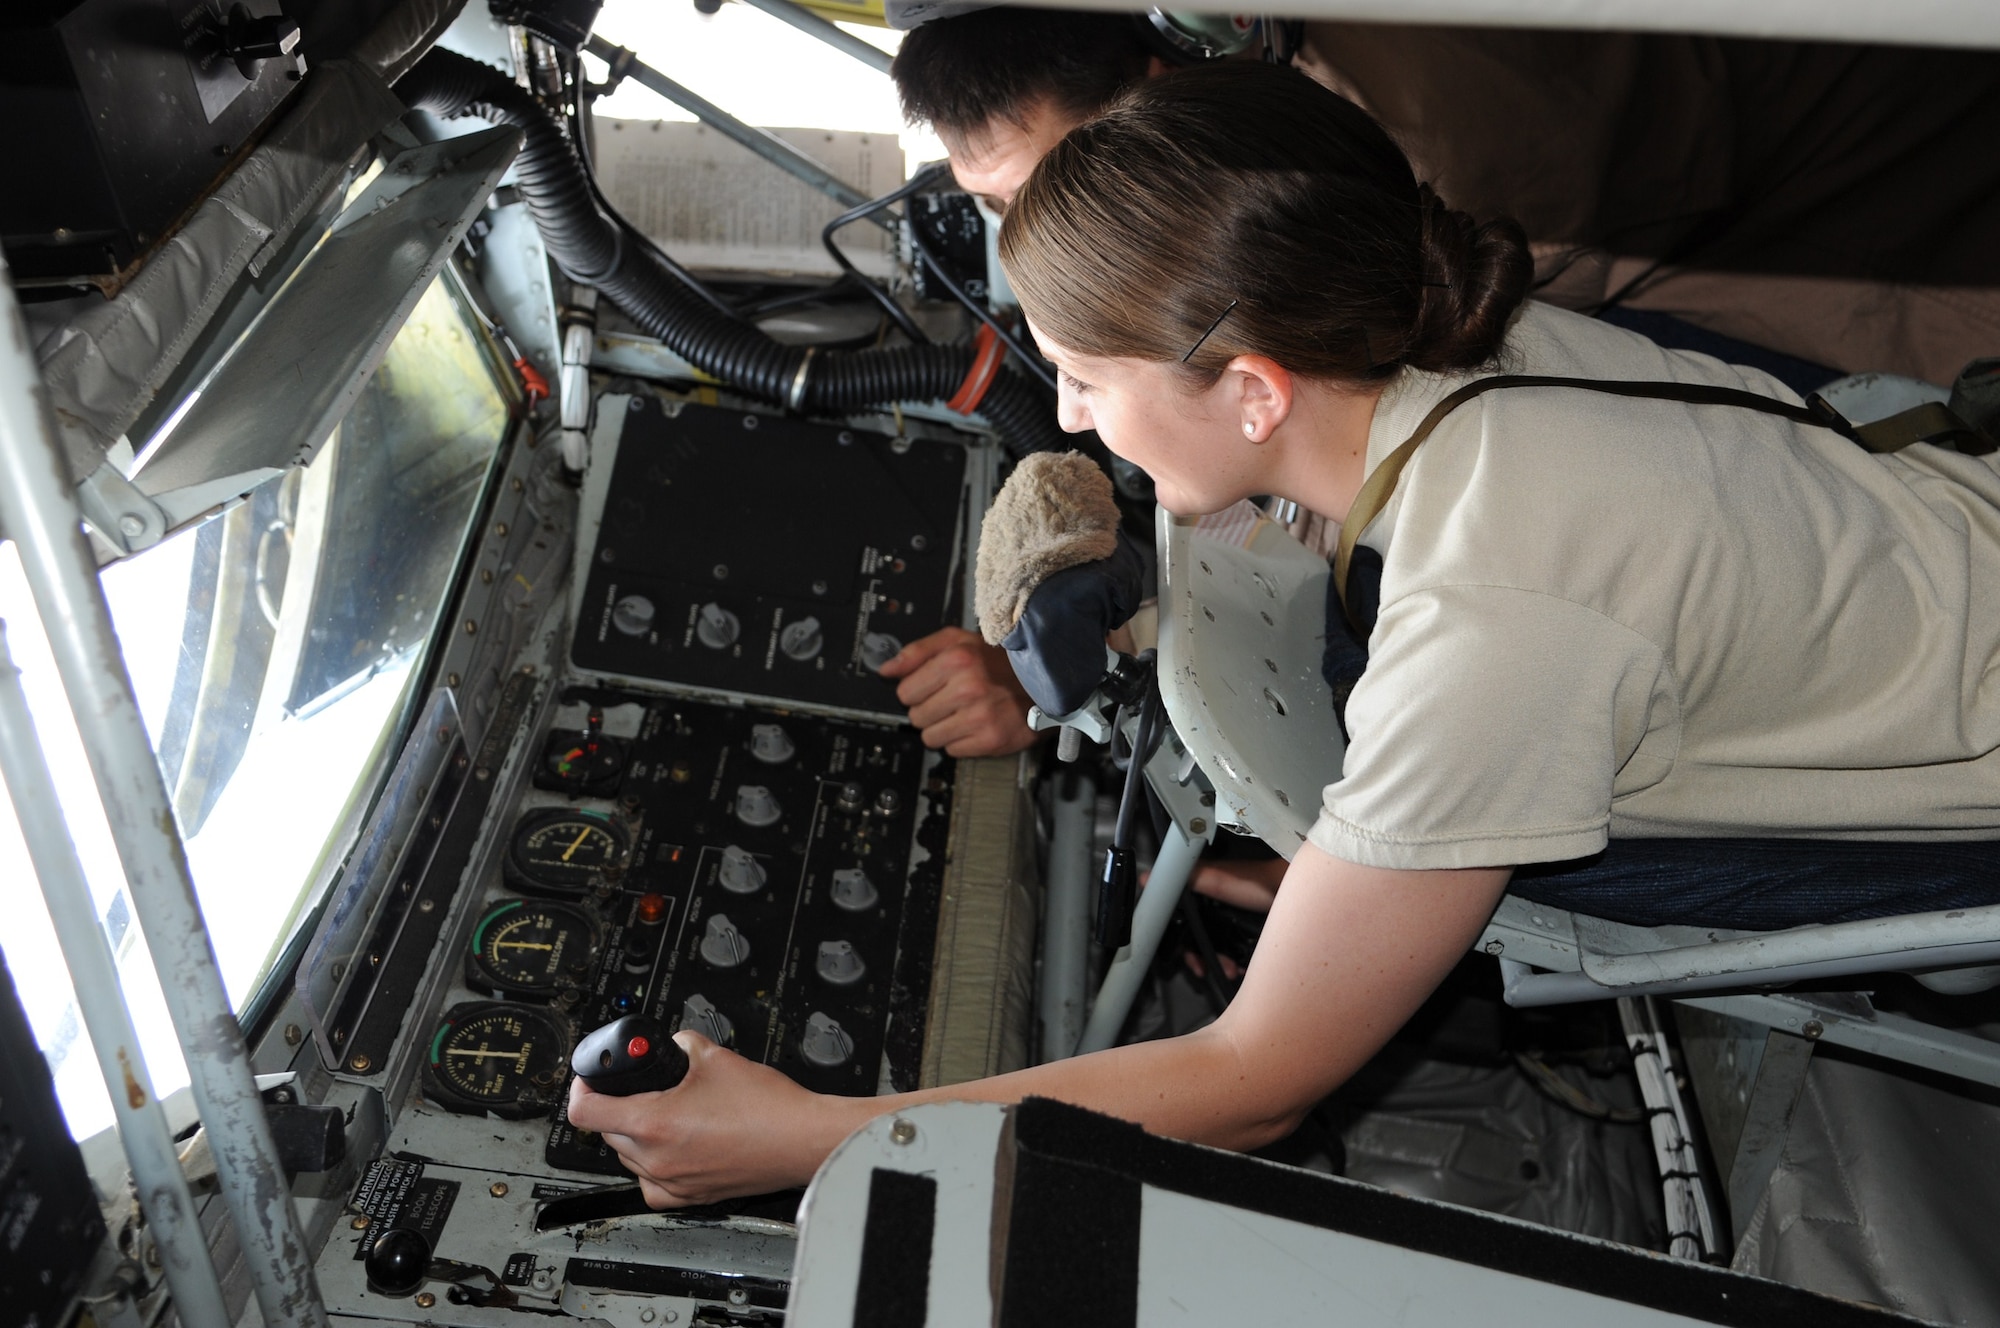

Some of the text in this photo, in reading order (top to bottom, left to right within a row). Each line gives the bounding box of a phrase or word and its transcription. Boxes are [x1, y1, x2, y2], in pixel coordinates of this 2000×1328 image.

[545, 930, 568, 973] TELESCOPING
[596, 925, 624, 995] SIGNAL SYSTEM STATUS
[658, 972, 673, 1001] DIRECTOR
[667, 950, 680, 971] LIGHTS
[511, 1021, 523, 1037] LEFT
[474, 1042, 489, 1064] DEGEES
[514, 1041, 533, 1074] AZIMUTH
[491, 1073, 506, 1093] RIGHT
[549, 1124, 564, 1148] AERIAL
[562, 1130, 572, 1144] TEST
[355, 1160, 382, 1206] WARNING
[366, 1165, 393, 1215] DO NOT TELESCO
[384, 1203, 400, 1229] MASTER
[396, 1176, 411, 1201] SWITCH
[407, 1163, 418, 1175] ON
[361, 1220, 381, 1252] WITHOUT
[379, 1190, 394, 1218] ELECTRIC
[412, 1193, 428, 1217] BOOM
[421, 1183, 448, 1231] TELESCOPE
[507, 1263, 517, 1275] FREE
